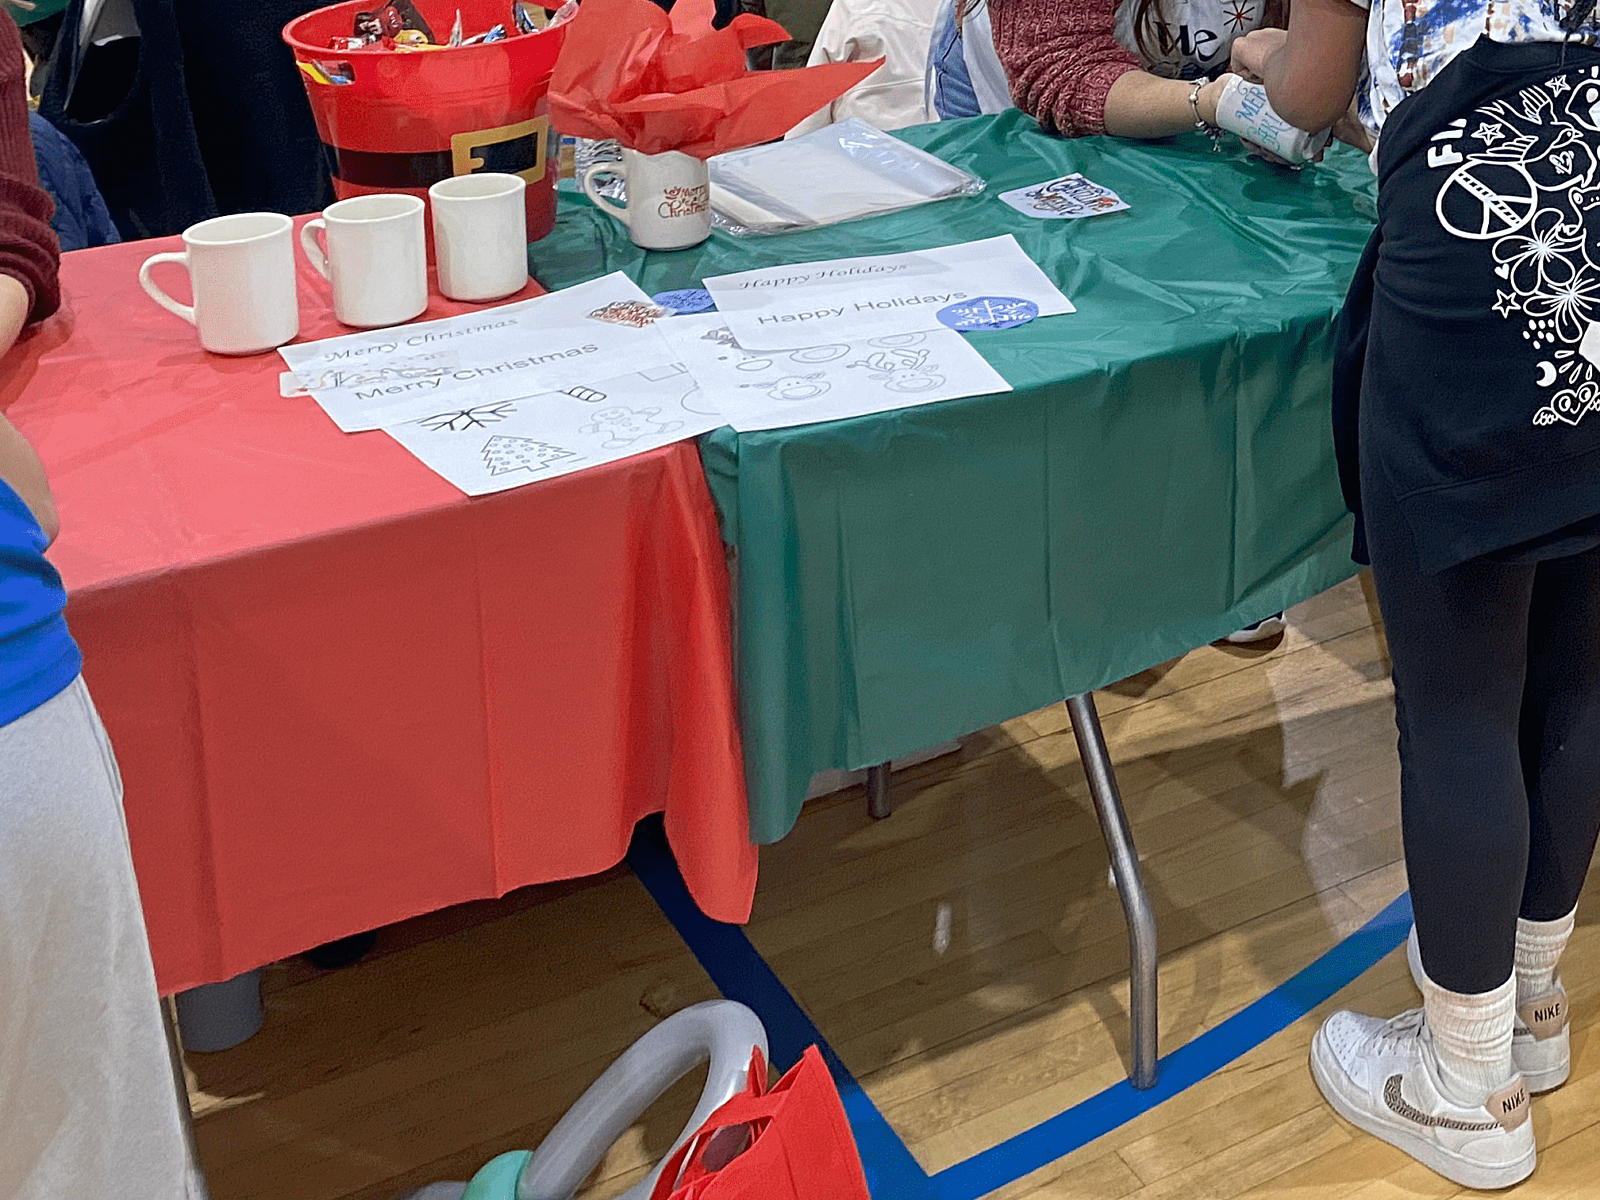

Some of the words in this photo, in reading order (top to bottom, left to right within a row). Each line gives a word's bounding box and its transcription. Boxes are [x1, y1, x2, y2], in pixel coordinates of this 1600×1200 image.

[739, 273, 811, 290] Happy
[815, 262, 909, 279] Holidays
[757, 305, 845, 325] Happy
[853, 291, 968, 313] Holidays
[324, 341, 399, 363] Merry
[406, 317, 519, 347] Christmas
[355, 377, 442, 400] Merry
[452, 343, 600, 382] Christmas
[1534, 1003, 1561, 1023] NIKE
[1502, 1087, 1526, 1114] NIKE
